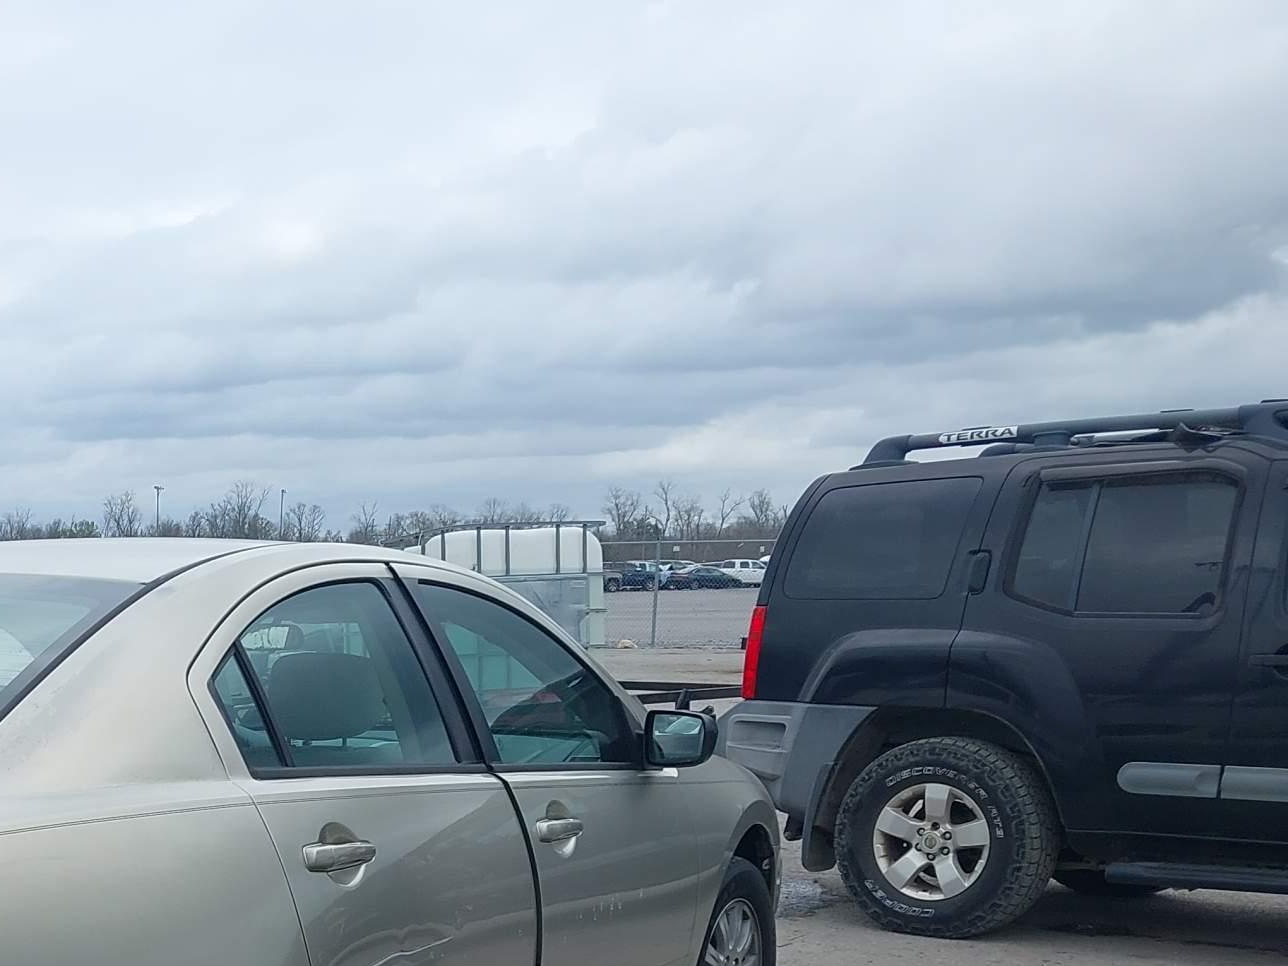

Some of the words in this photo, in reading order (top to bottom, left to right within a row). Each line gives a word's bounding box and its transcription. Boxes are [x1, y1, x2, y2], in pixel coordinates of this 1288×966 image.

[943, 427, 1015, 443] TERRA
[885, 766, 988, 801] DISCOVERER
[864, 879, 935, 918] COOPER
